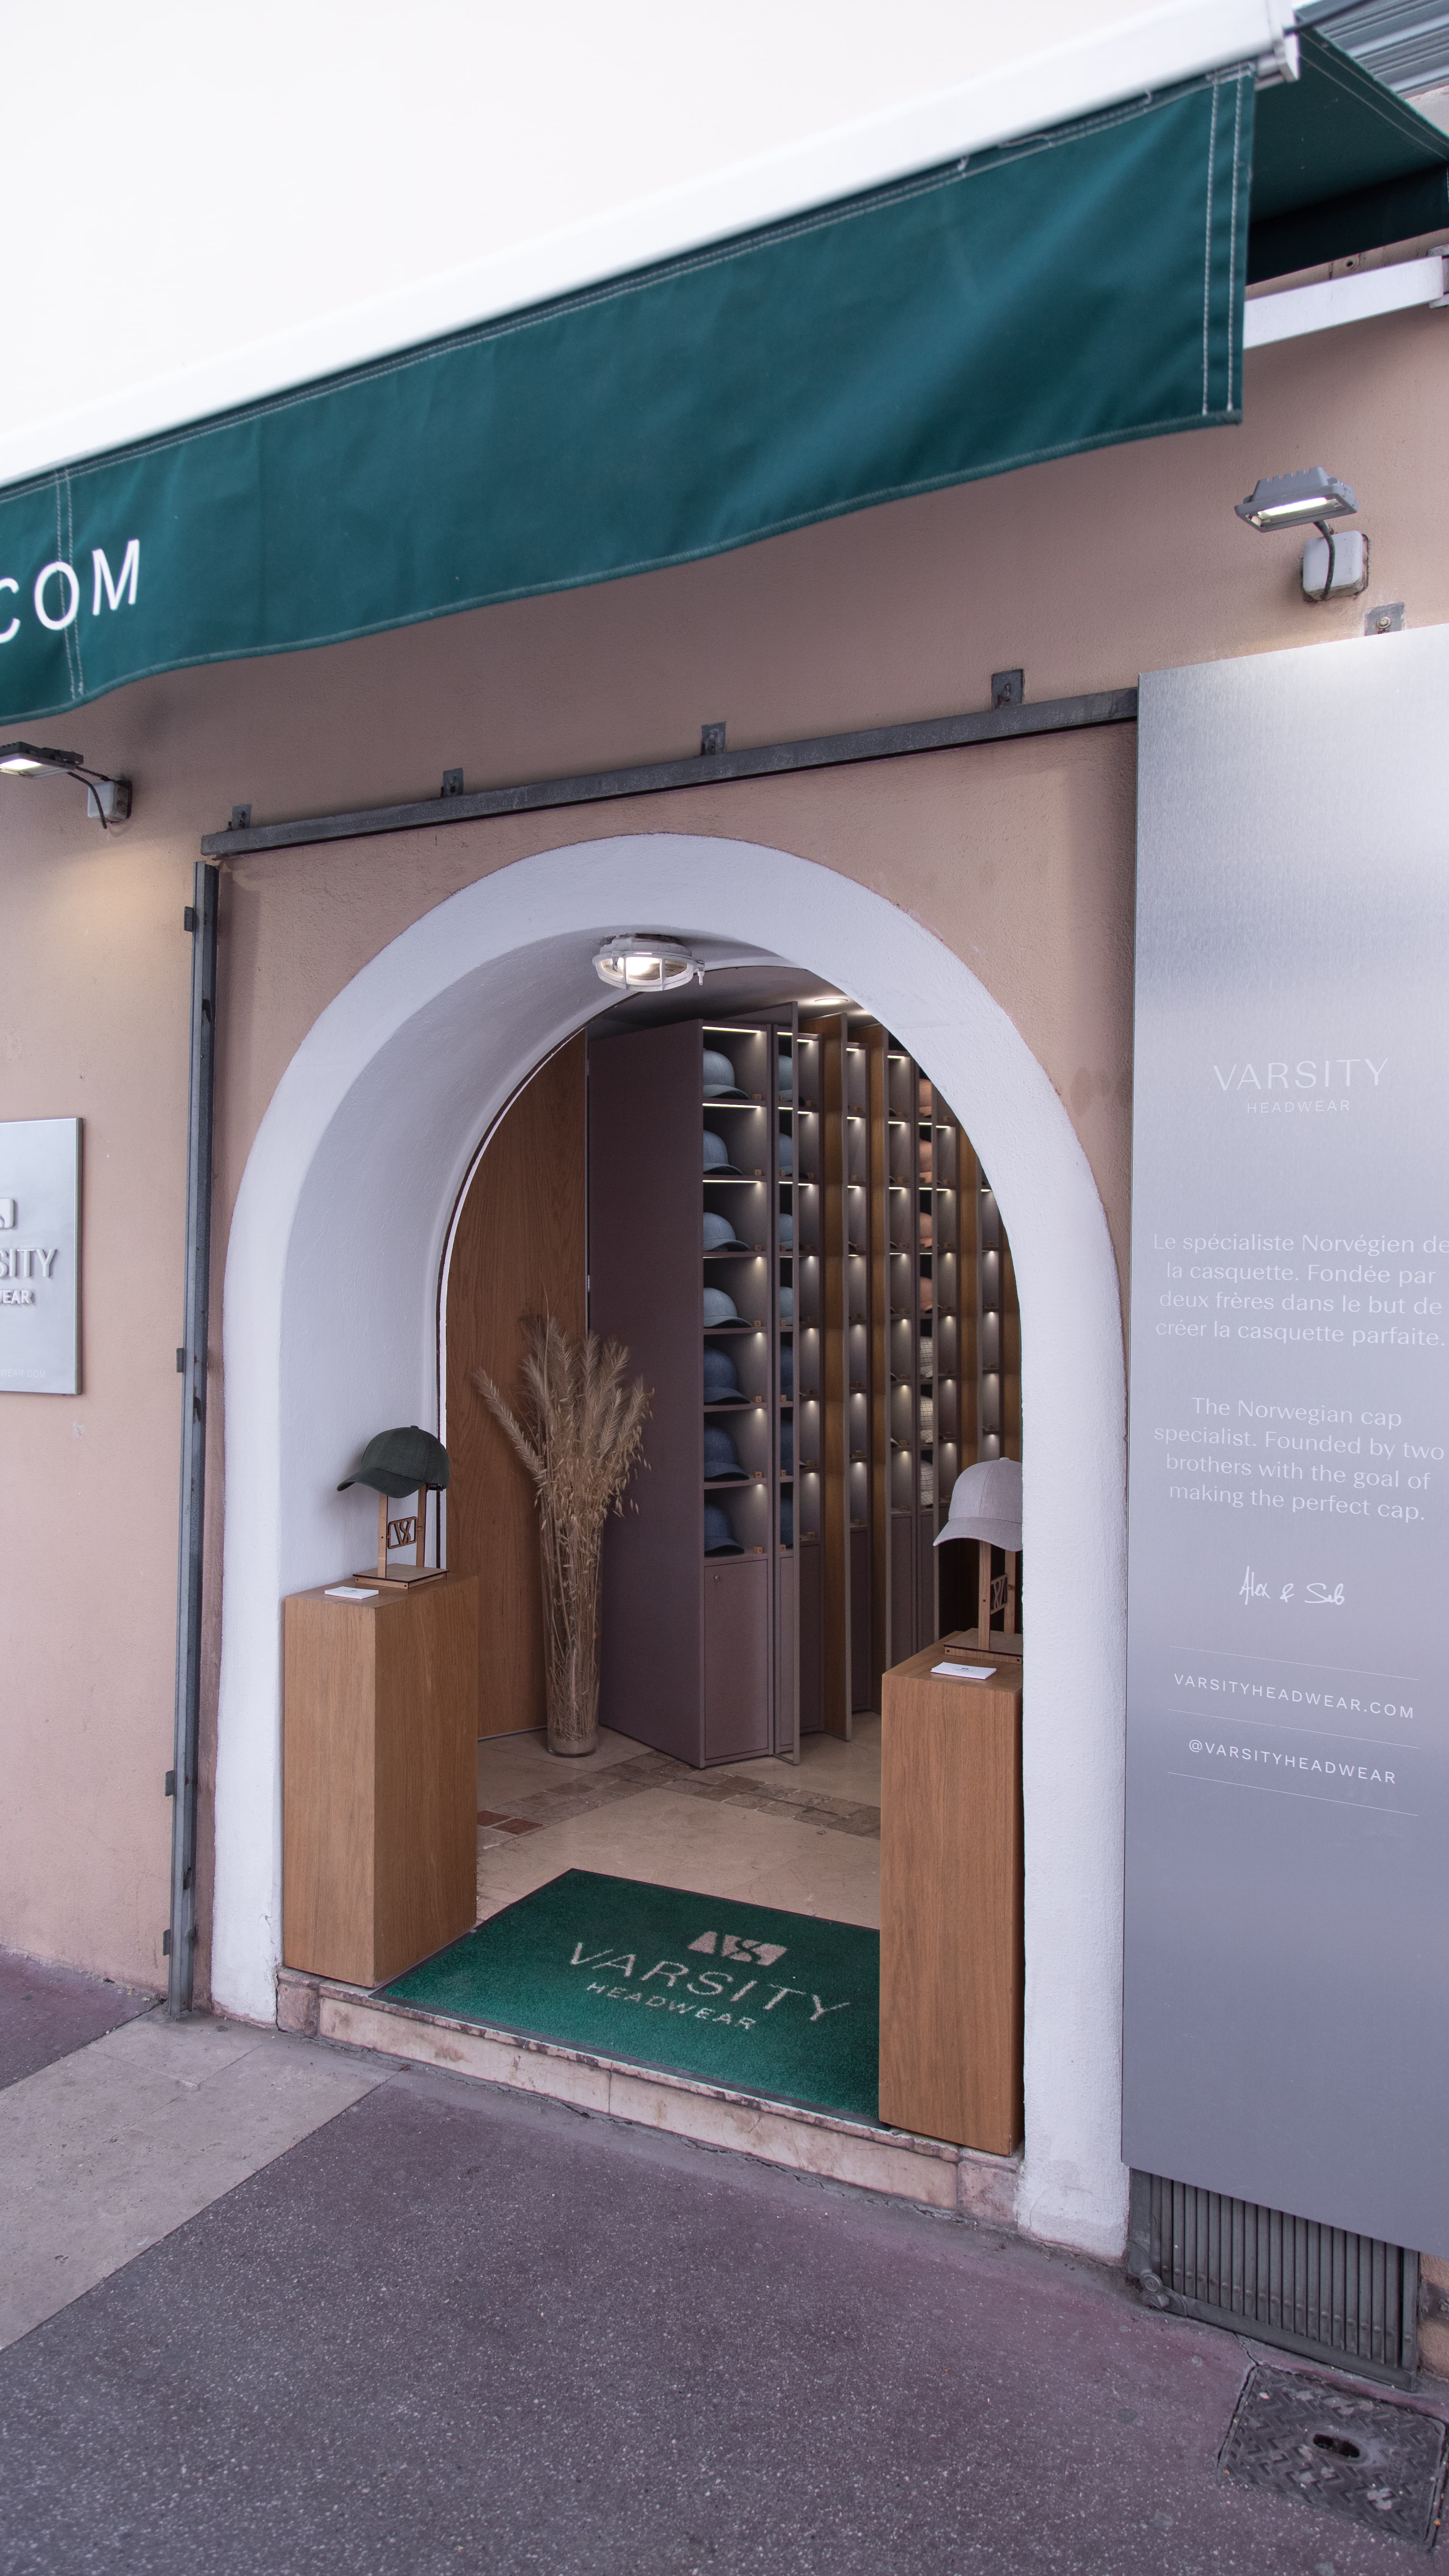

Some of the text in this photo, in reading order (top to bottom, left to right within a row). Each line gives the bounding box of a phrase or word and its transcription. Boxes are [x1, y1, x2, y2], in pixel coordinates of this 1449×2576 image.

[1213, 1058, 1388, 1091] VARSITY
[1247, 1099, 1350, 1114] HEADWEAR
[1154, 1233, 1449, 1257] Le spécialiste Norvégien de
[1167, 1261, 1436, 1288] la casquette. Fondée par
[0, 1289, 34, 1304] EAR
[1159, 1290, 1442, 1315] deux frères dans le but de
[1155, 1319, 1445, 1347] créer la casquette parfaite.
[1191, 1397, 1402, 1431] The Norwegian cap
[1154, 1427, 1445, 1460] specialist. Founded by two
[1166, 1452, 1431, 1490] brothers with the goal of
[1170, 1484, 1425, 1524] making the perfect cap.
[1279, 1582, 1295, 1603] &
[1173, 1673, 1414, 1719] VARSITYHEADWEAR.COM
[1188, 1739, 1396, 1785] @VARSITYHEADWEAR
[570, 1942, 851, 2021] VARSITY
[586, 1981, 756, 2029] HEADWEAR
